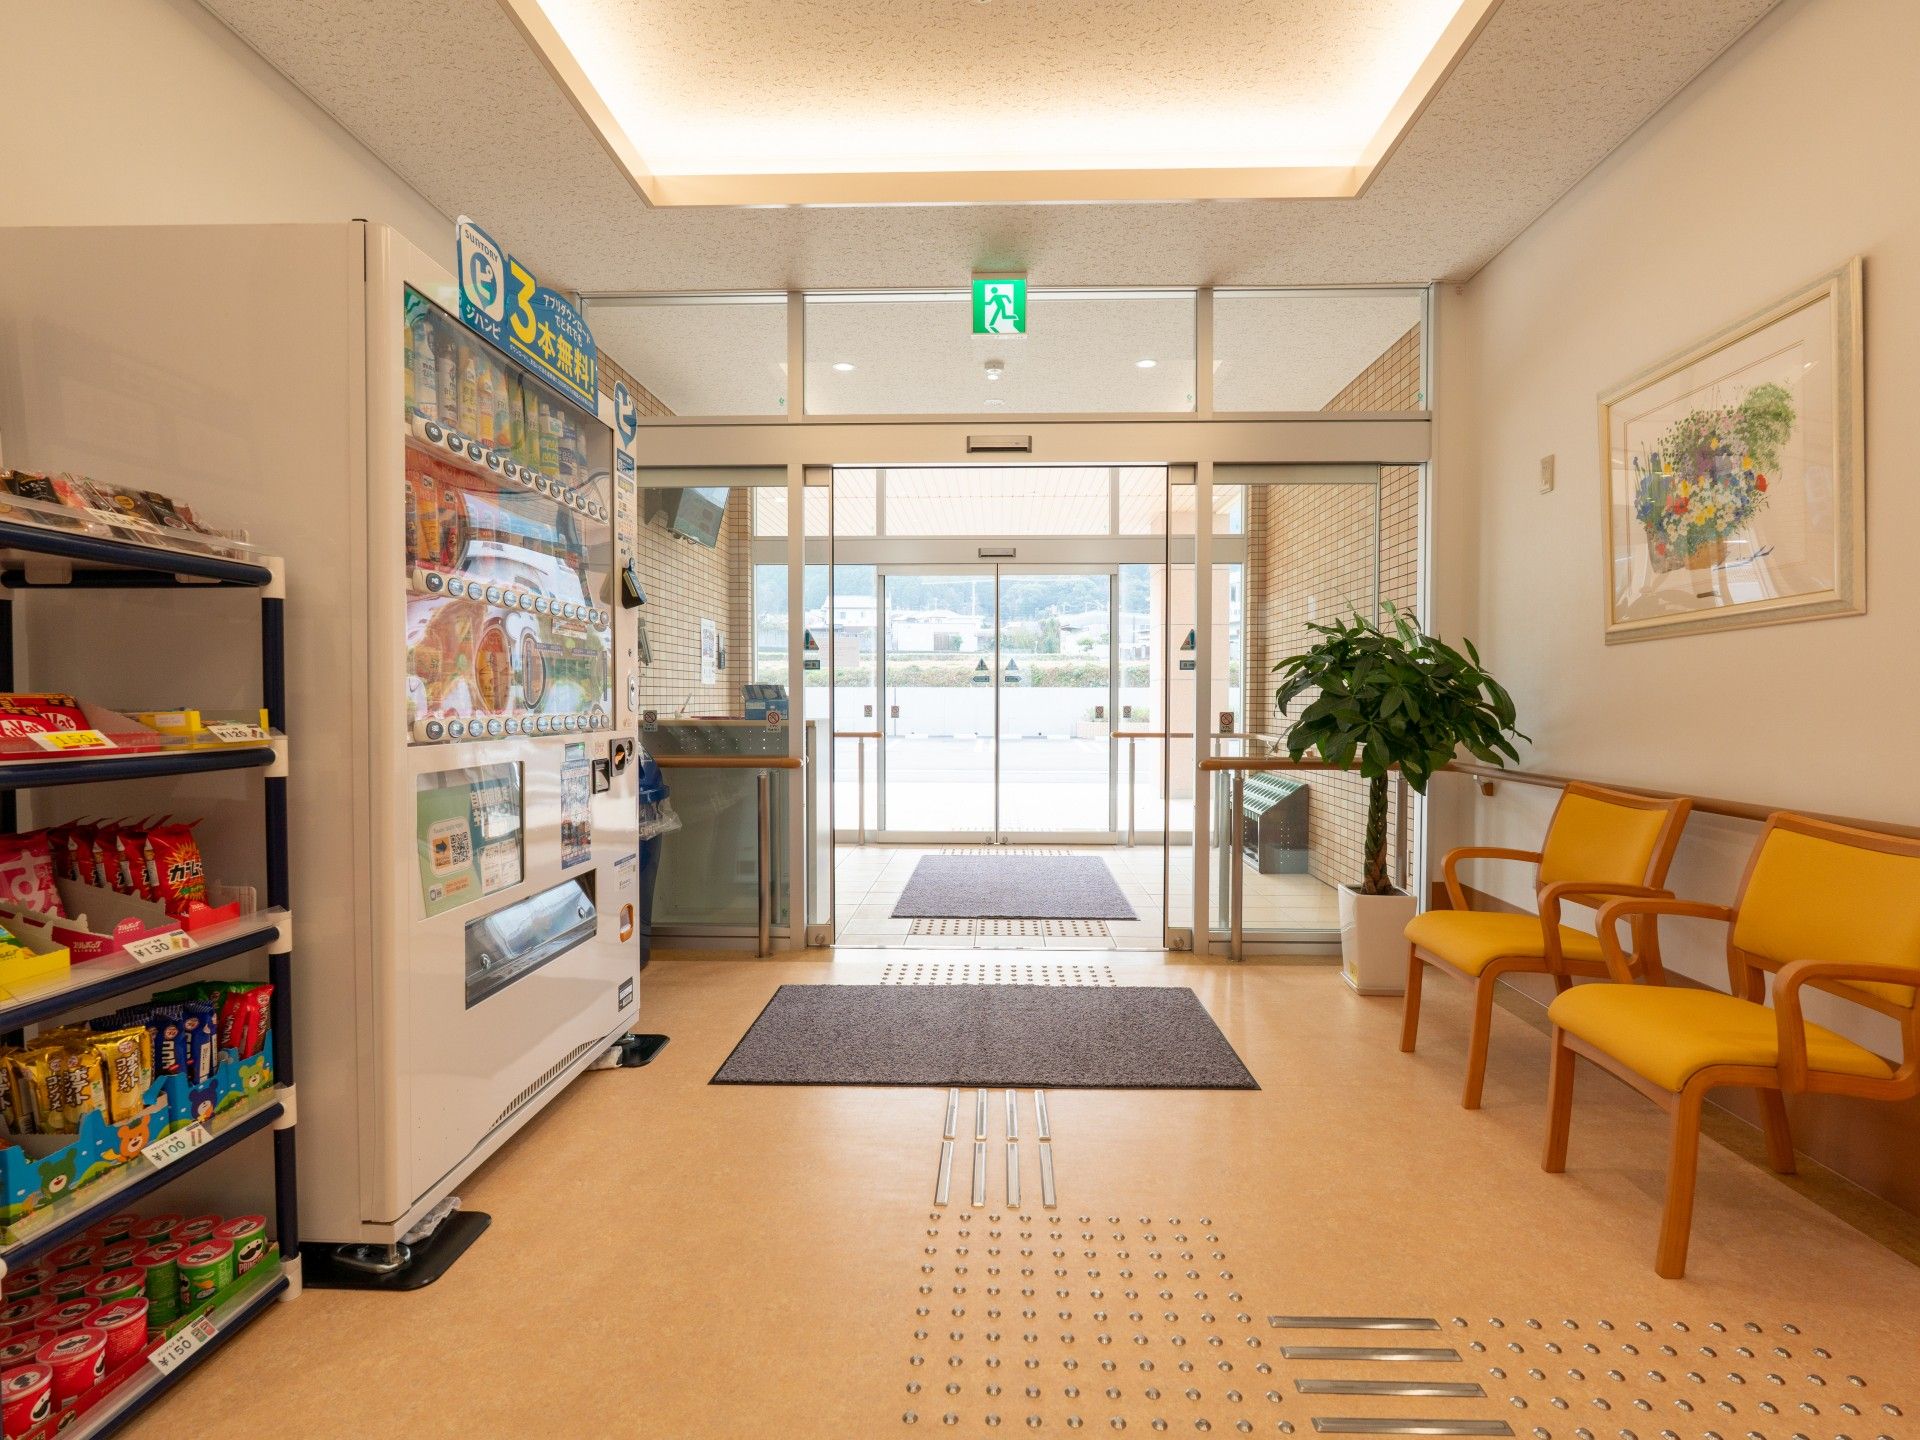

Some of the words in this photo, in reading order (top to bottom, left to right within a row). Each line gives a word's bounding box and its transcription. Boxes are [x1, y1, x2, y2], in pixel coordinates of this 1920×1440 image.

[464, 229, 499, 263] SUNTORY
[543, 294, 591, 344] アプリダウンロード
[134, 942, 170, 958] ¥130
[126, 1050, 140, 1088] ポテト
[71, 1068, 90, 1105] ポテト
[152, 1140, 186, 1161] ¥100
[158, 1340, 192, 1367] ¥150
